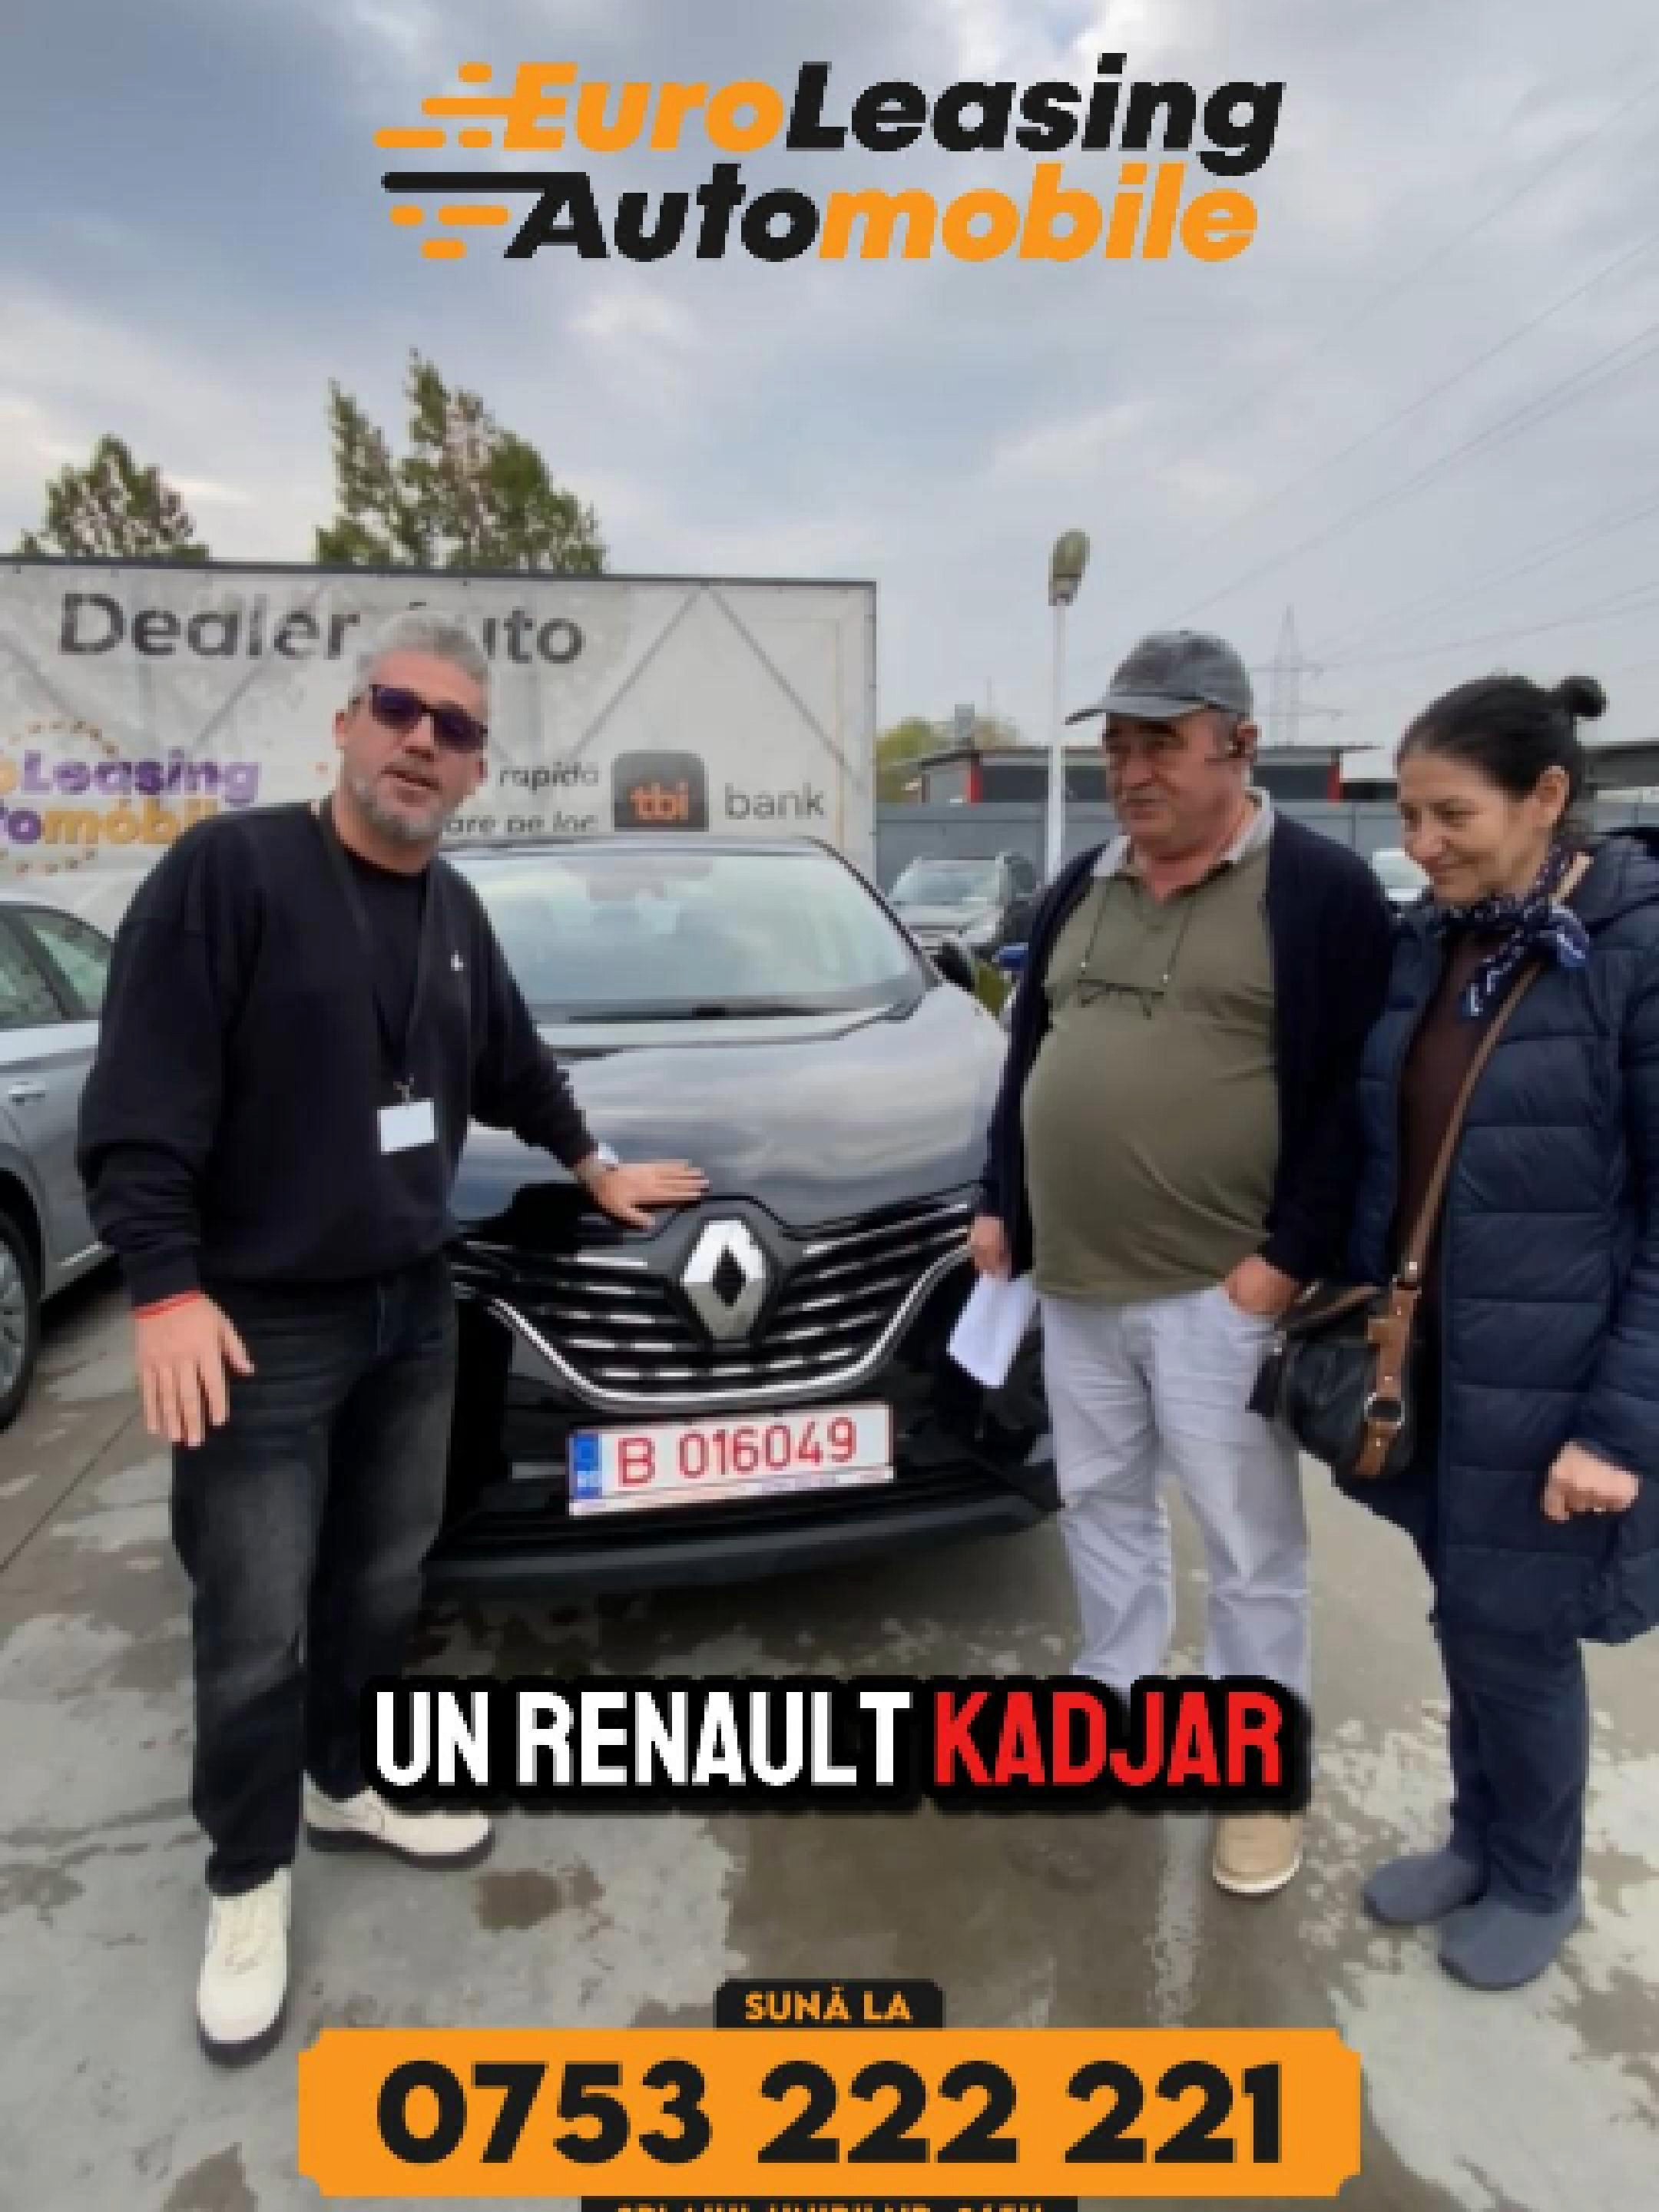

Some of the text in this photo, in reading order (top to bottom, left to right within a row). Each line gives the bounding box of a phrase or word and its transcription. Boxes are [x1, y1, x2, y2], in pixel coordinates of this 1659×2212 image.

[58, 591, 359, 659] Dealer
[630, 778, 825, 821] tbi bank
[617, 1416, 857, 1486] B 016049
